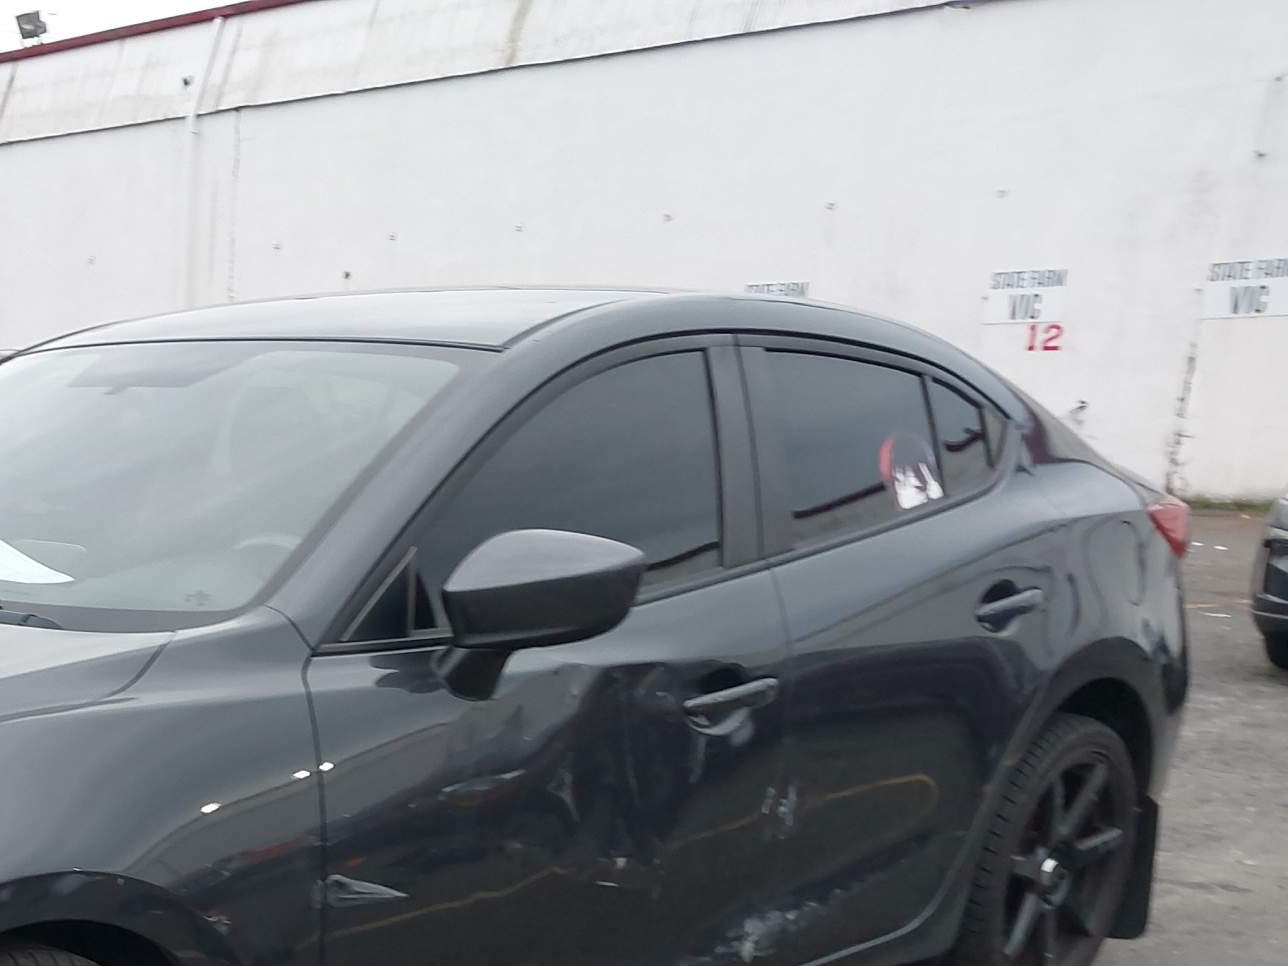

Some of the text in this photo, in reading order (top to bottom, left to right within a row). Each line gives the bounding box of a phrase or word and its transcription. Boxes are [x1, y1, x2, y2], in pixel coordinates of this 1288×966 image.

[991, 269, 1067, 289] STATE FARM
[1207, 261, 1252, 282] STATE
[1027, 325, 1063, 351] 12
